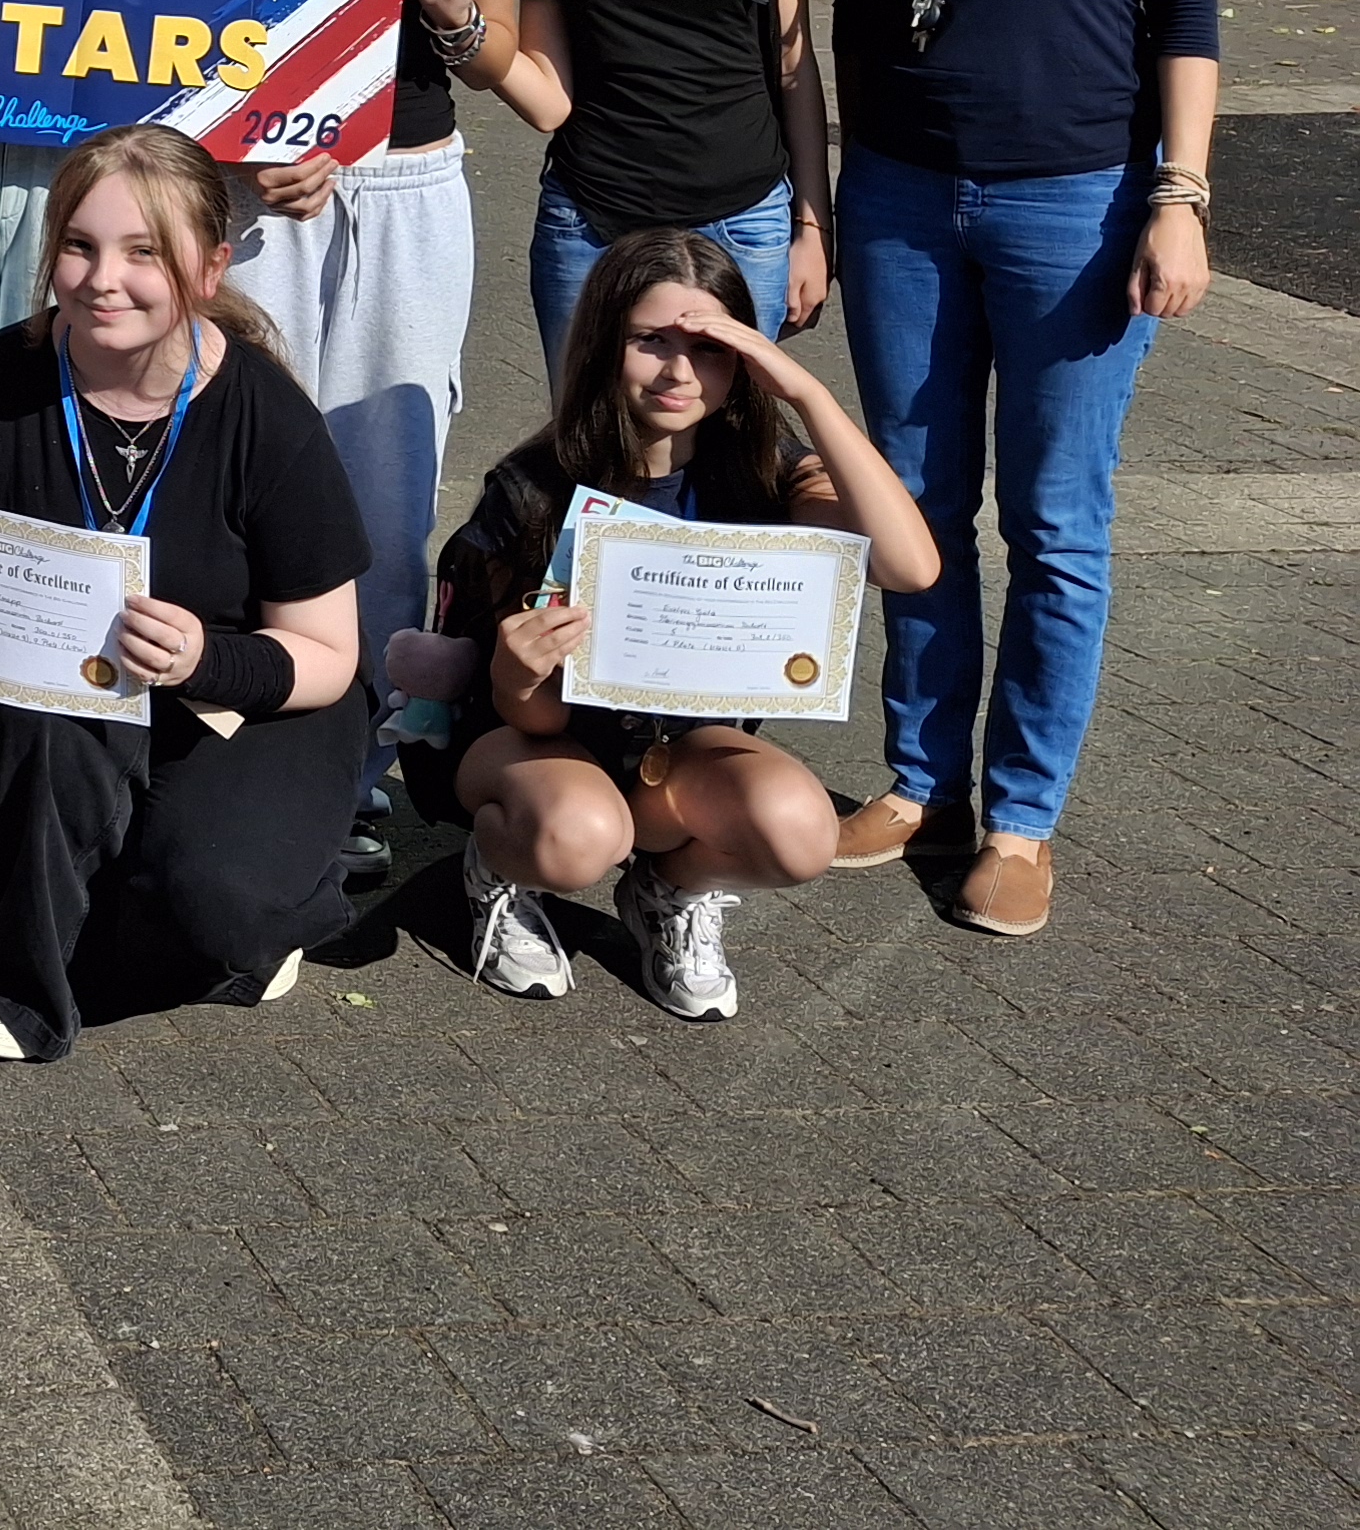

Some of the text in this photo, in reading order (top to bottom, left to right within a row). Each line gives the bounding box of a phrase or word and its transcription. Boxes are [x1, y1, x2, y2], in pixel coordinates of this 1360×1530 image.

[241, 110, 343, 149] 2026
[698, 555, 723, 568] BIG
[7, 565, 20, 578] of
[23, 568, 92, 595] Excellence
[630, 566, 804, 592] Certificate of Excellence
